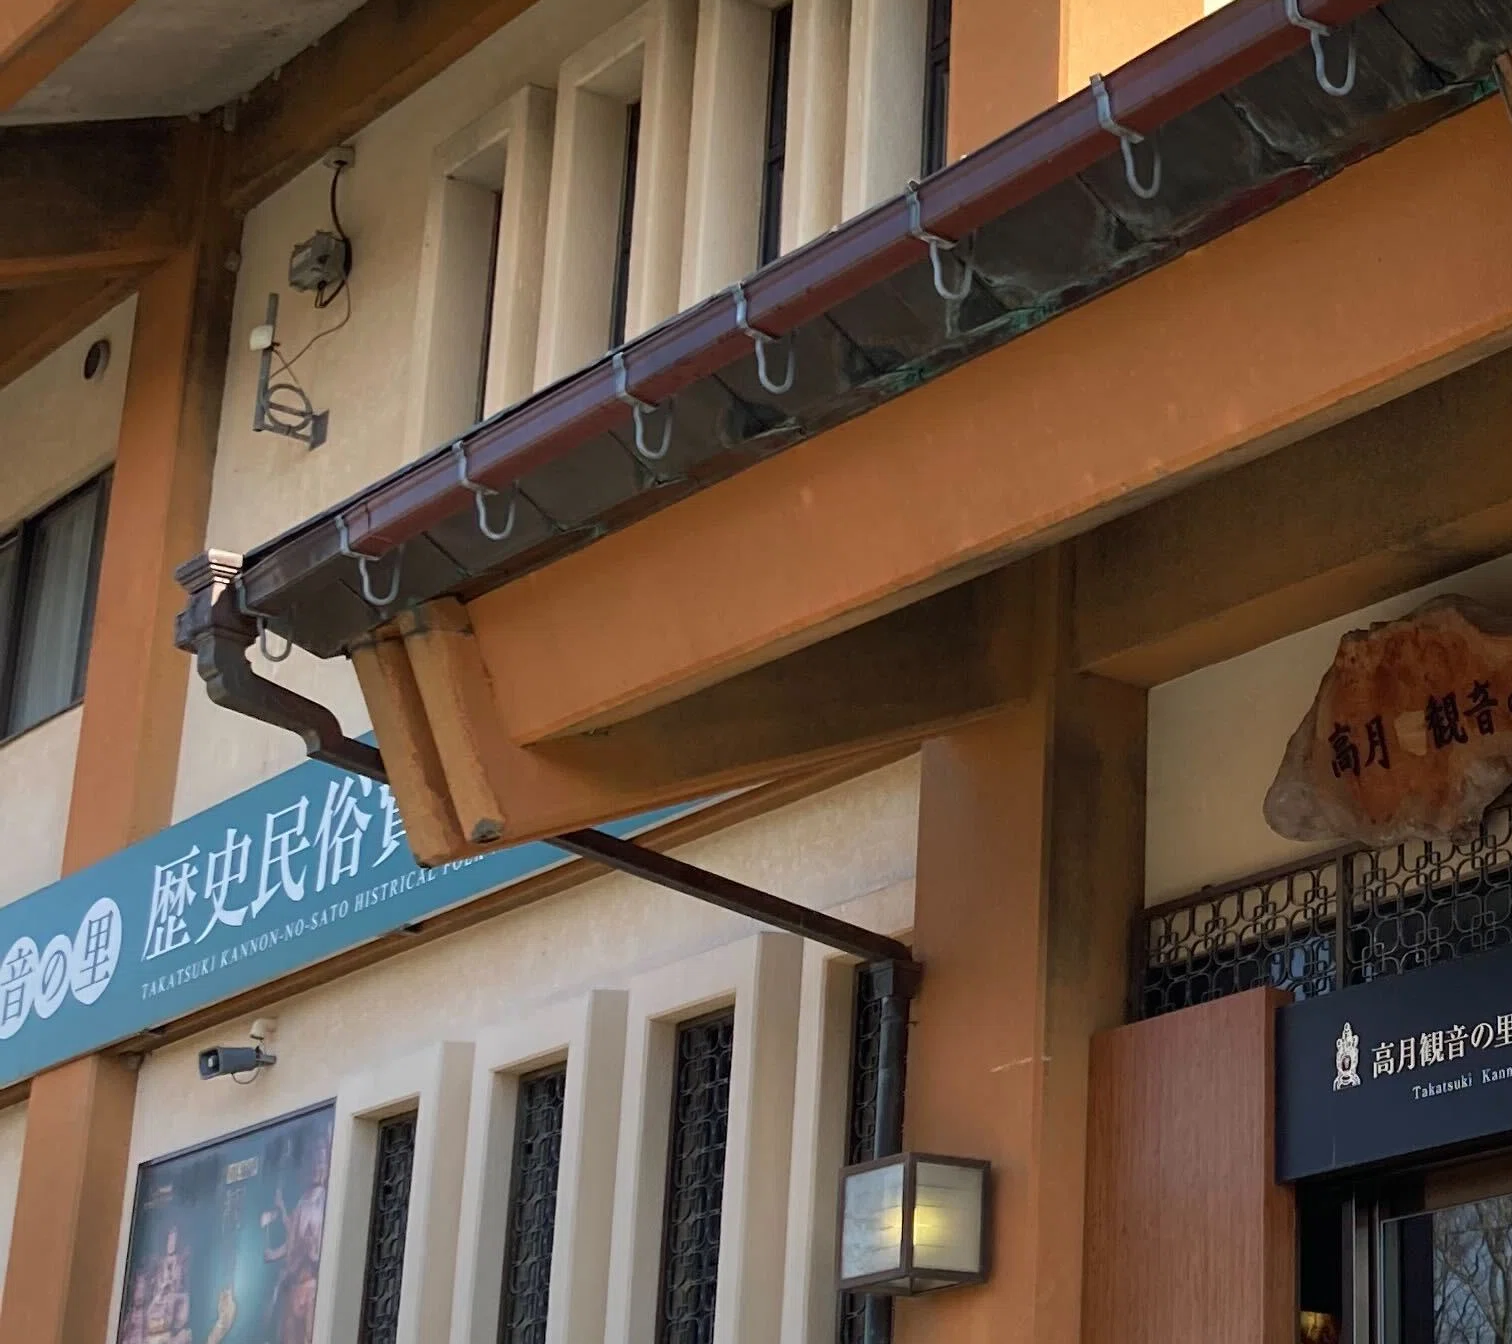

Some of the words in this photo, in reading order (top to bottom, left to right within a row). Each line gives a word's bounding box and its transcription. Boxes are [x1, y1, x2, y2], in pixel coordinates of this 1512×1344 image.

[141, 954, 217, 1001] TAKATSUKI
[220, 899, 349, 969] KANNON-NO-SATO
[354, 869, 436, 913] HISTRICAL
[1412, 1072, 1473, 1100] Takatsuki
